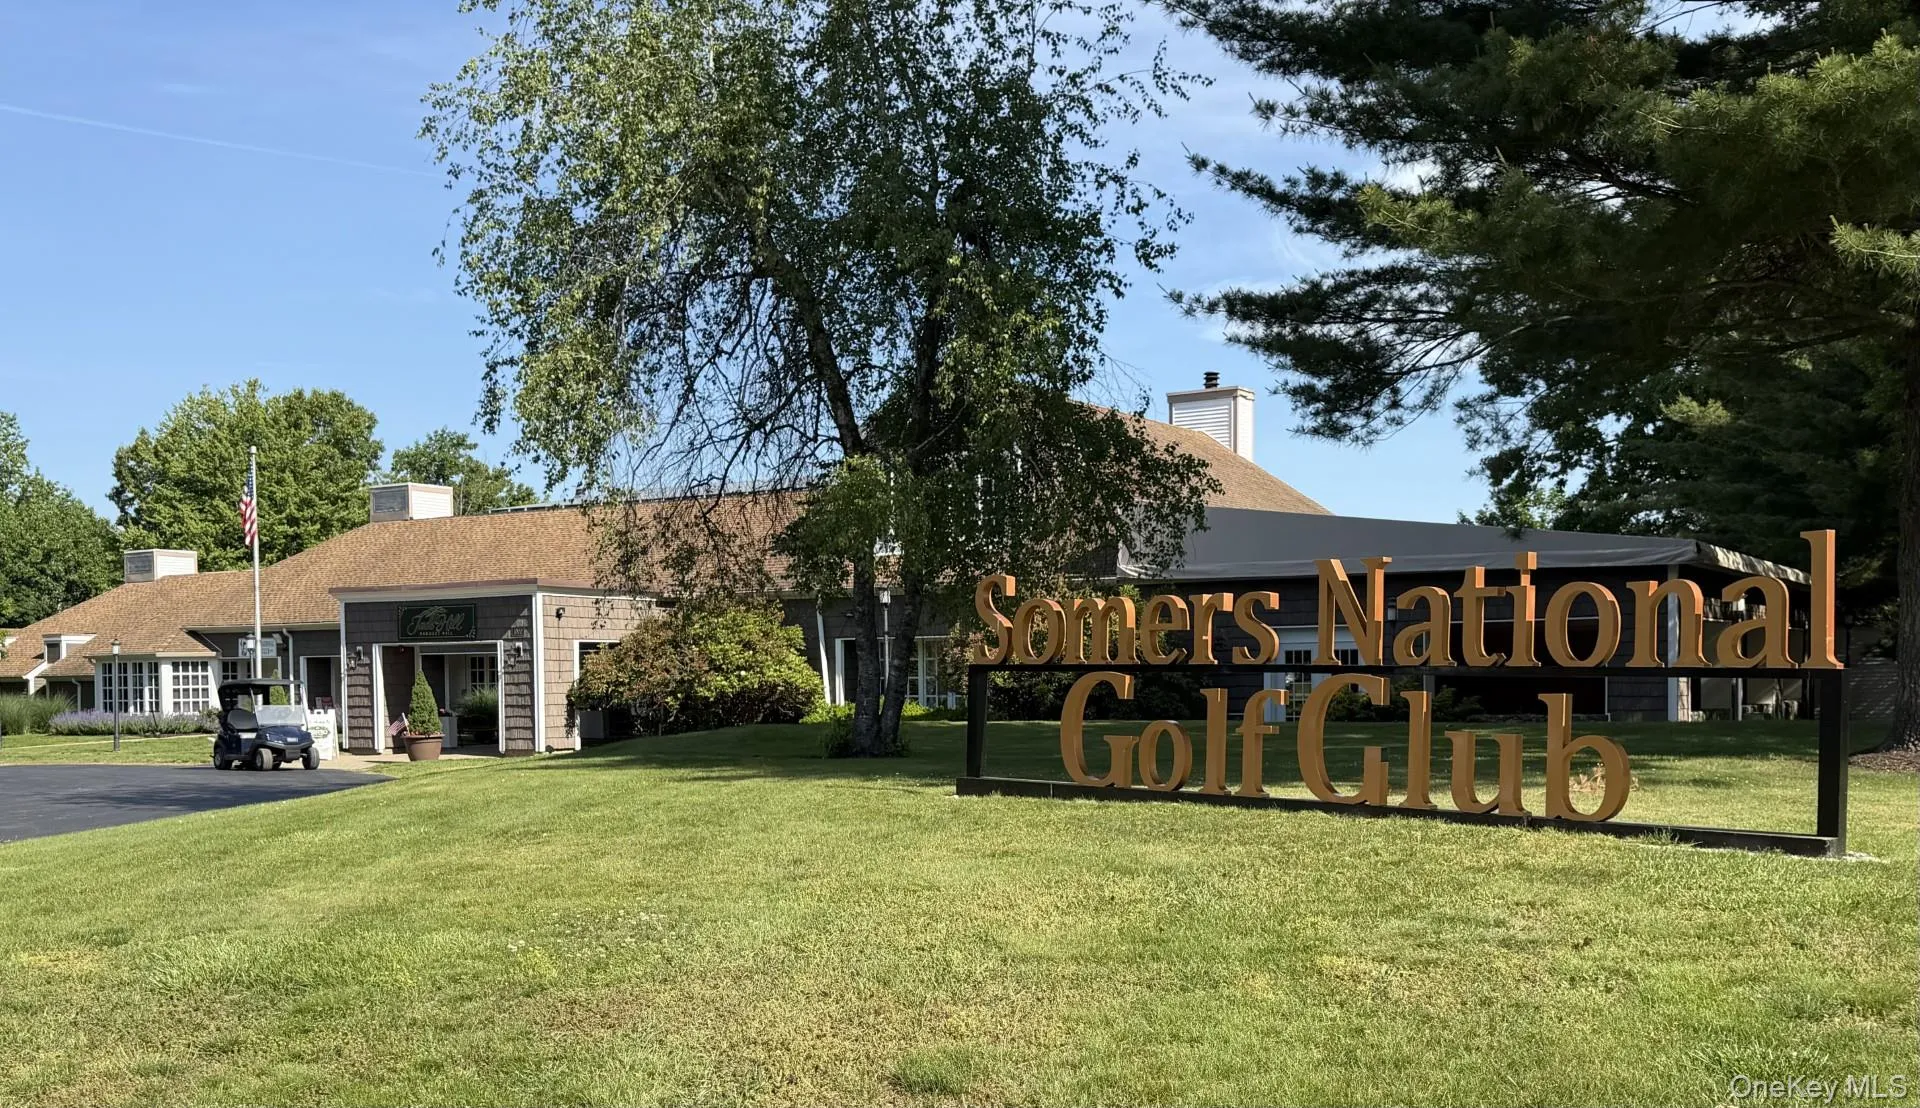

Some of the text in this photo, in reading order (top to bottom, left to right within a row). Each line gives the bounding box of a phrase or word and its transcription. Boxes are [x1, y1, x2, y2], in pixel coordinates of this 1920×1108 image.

[974, 529, 1845, 670] Somers National
[1060, 672, 1289, 798] Golf
